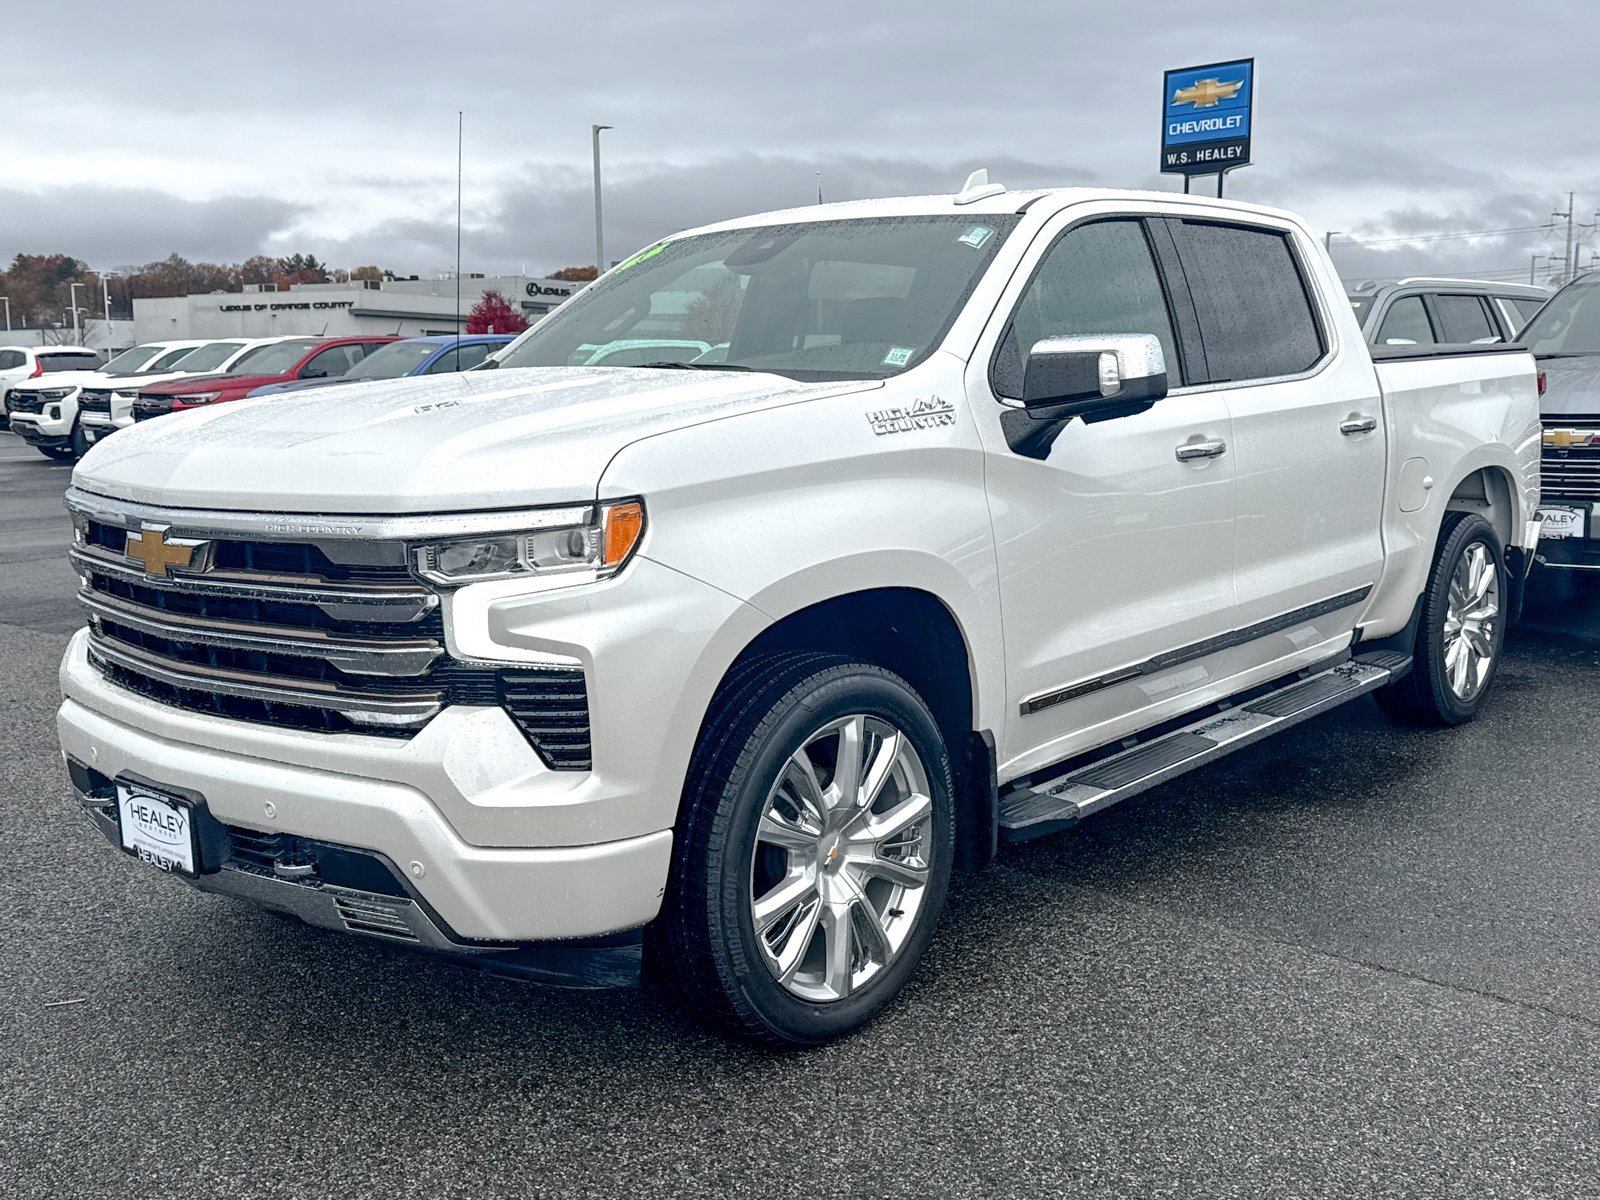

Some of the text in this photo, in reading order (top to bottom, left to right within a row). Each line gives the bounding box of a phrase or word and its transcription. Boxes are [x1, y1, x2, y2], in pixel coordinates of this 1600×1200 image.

[1169, 115, 1243, 136] CHEVROLET
[1167, 145, 1243, 165] W.S. HEALEY
[538, 286, 571, 297] LEXUS
[220, 304, 252, 312] LEXUS
[270, 302, 311, 311] ORANGE
[312, 301, 354, 310] COUNTY
[865, 407, 912, 425] HIGH
[872, 412, 957, 436] COUNTRY
[1544, 514, 1577, 523] ALEY
[299, 525, 362, 535] COUNTRY
[129, 802, 184, 836] HEALEY
[137, 846, 173, 872] HEALEY
